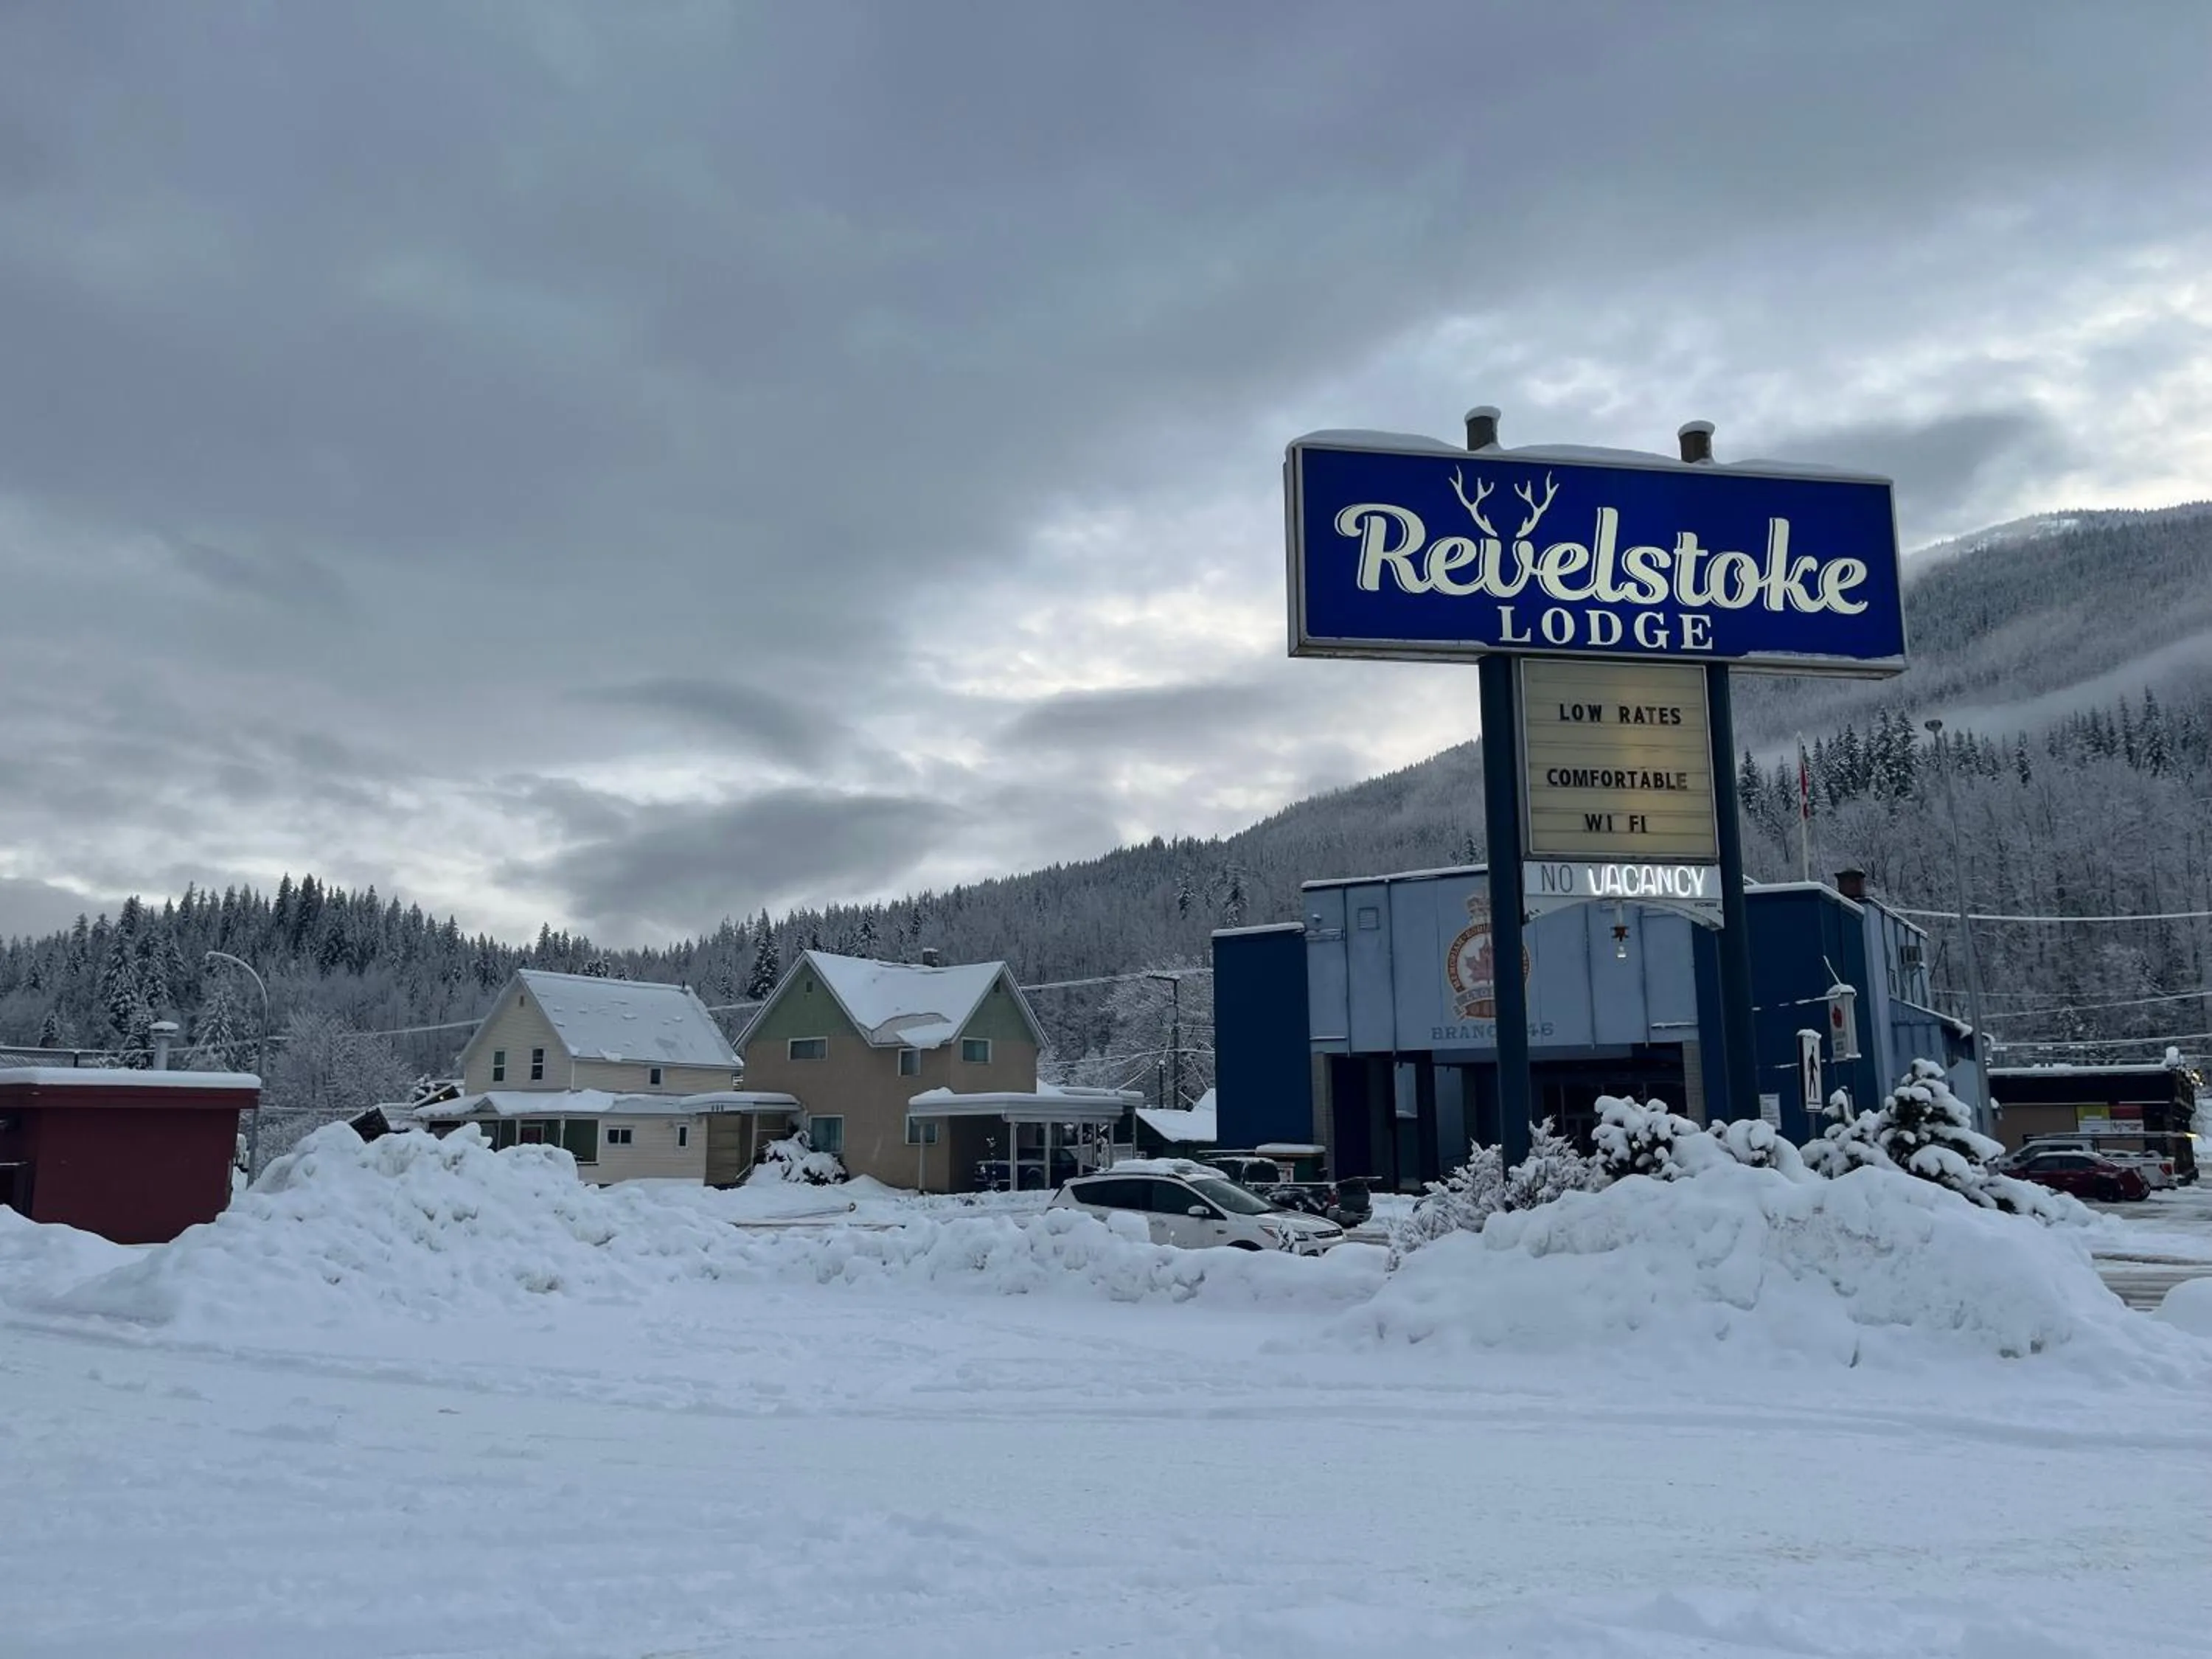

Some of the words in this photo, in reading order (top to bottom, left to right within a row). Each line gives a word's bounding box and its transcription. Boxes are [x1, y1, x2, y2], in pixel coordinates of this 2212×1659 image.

[1335, 503, 1868, 615] Revelstoke
[1497, 605, 1714, 650] LODGE
[1559, 703, 1602, 723] LOW
[1618, 706, 1682, 725] RATES
[1546, 768, 1688, 790] COMFORTABLE
[1585, 813, 1613, 832] WI
[1629, 815, 1647, 833] FI
[1541, 864, 1573, 893] NO
[1587, 863, 1706, 897] VACANCY
[1431, 1024, 1496, 1040] BRANC
